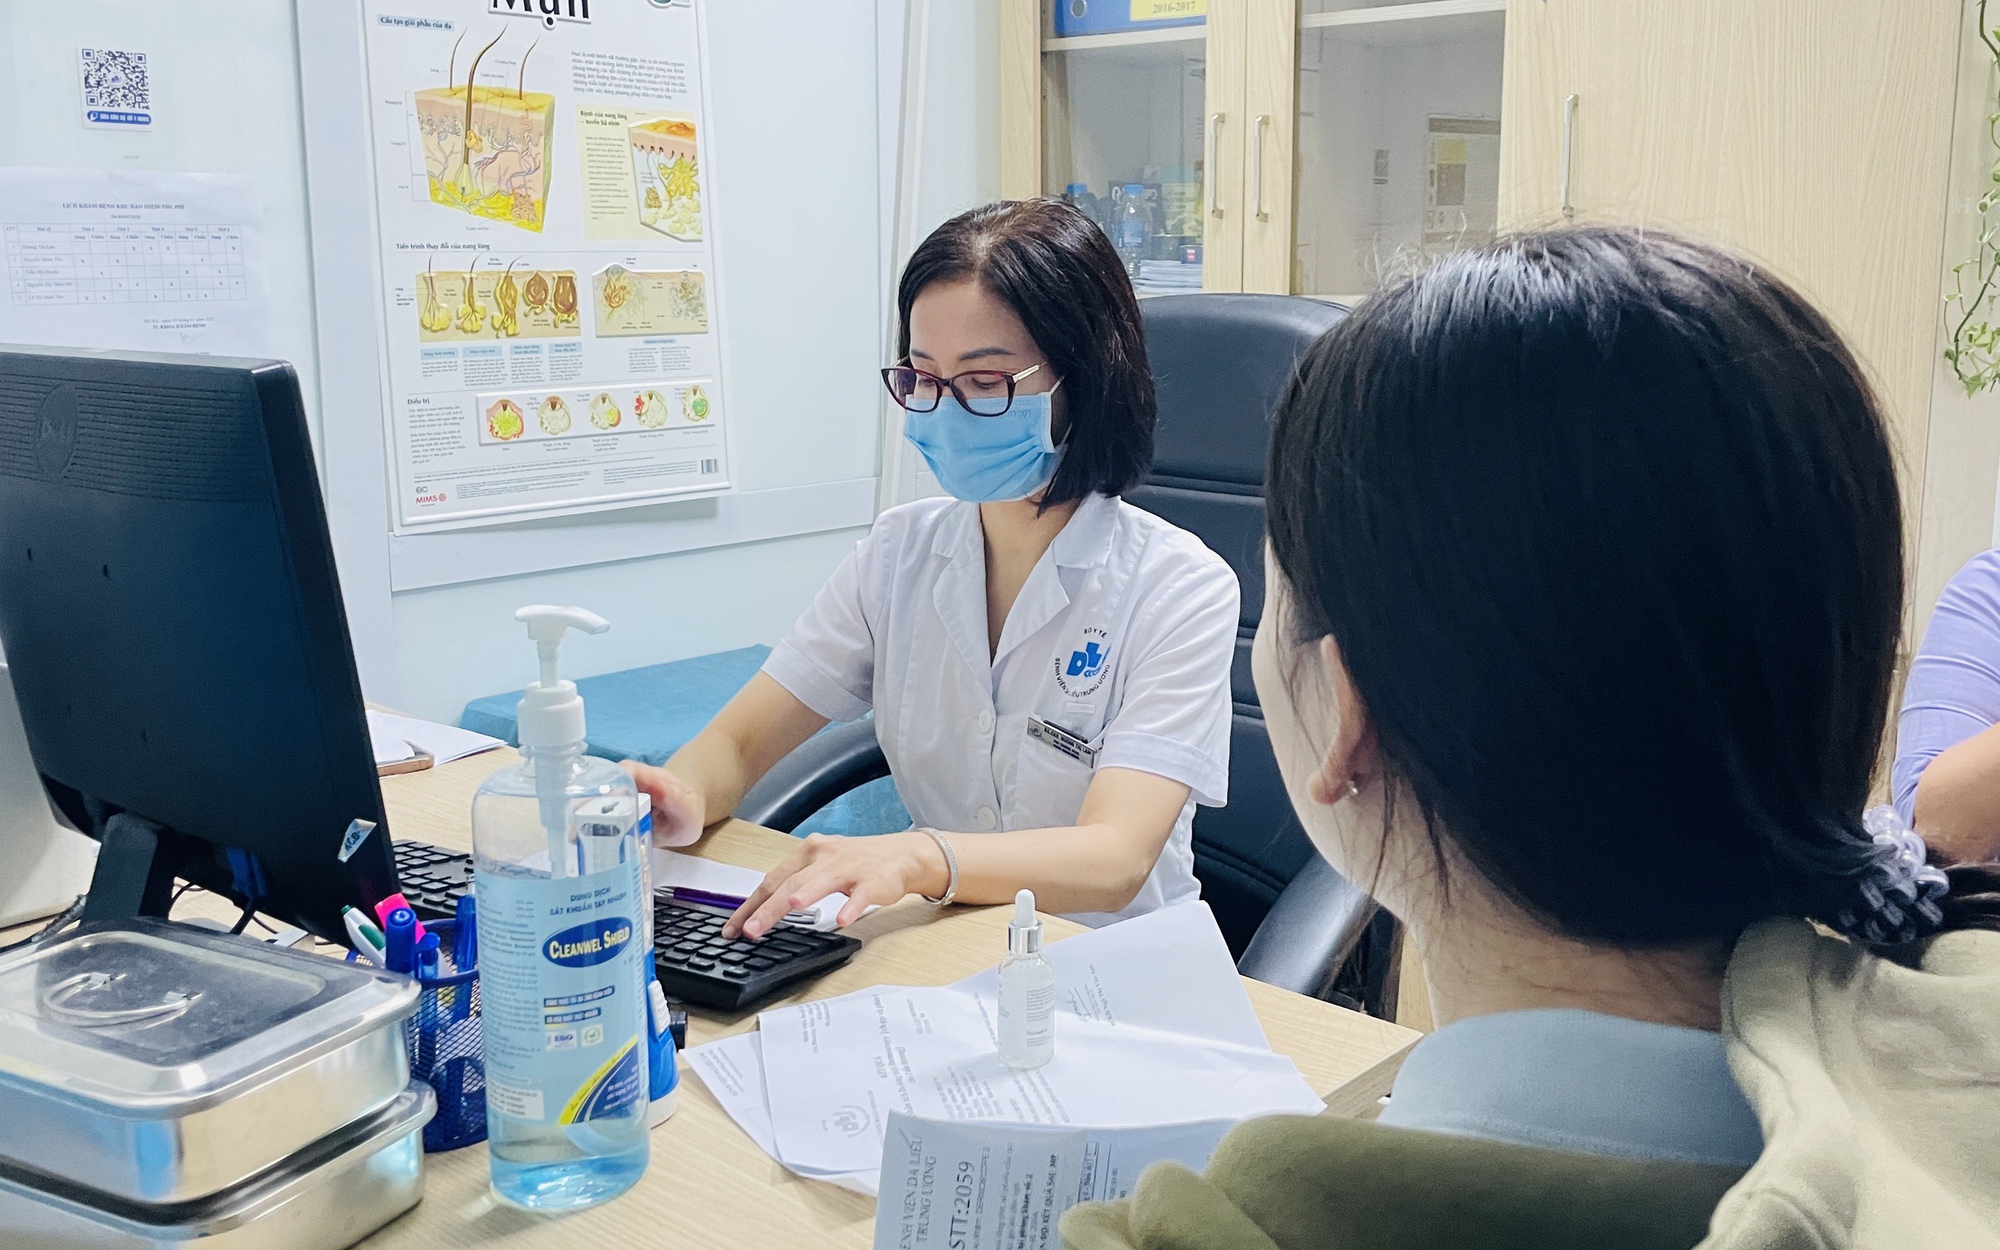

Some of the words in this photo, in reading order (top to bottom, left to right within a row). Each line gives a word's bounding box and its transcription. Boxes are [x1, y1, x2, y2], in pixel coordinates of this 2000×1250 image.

[493, 0, 589, 26] ụn
[1152, 1, 1196, 14] 2016-2017
[416, 495, 438, 504] MIMS
[603, 926, 630, 949] SHIELD
[949, 1161, 975, 1250] STT:2059
